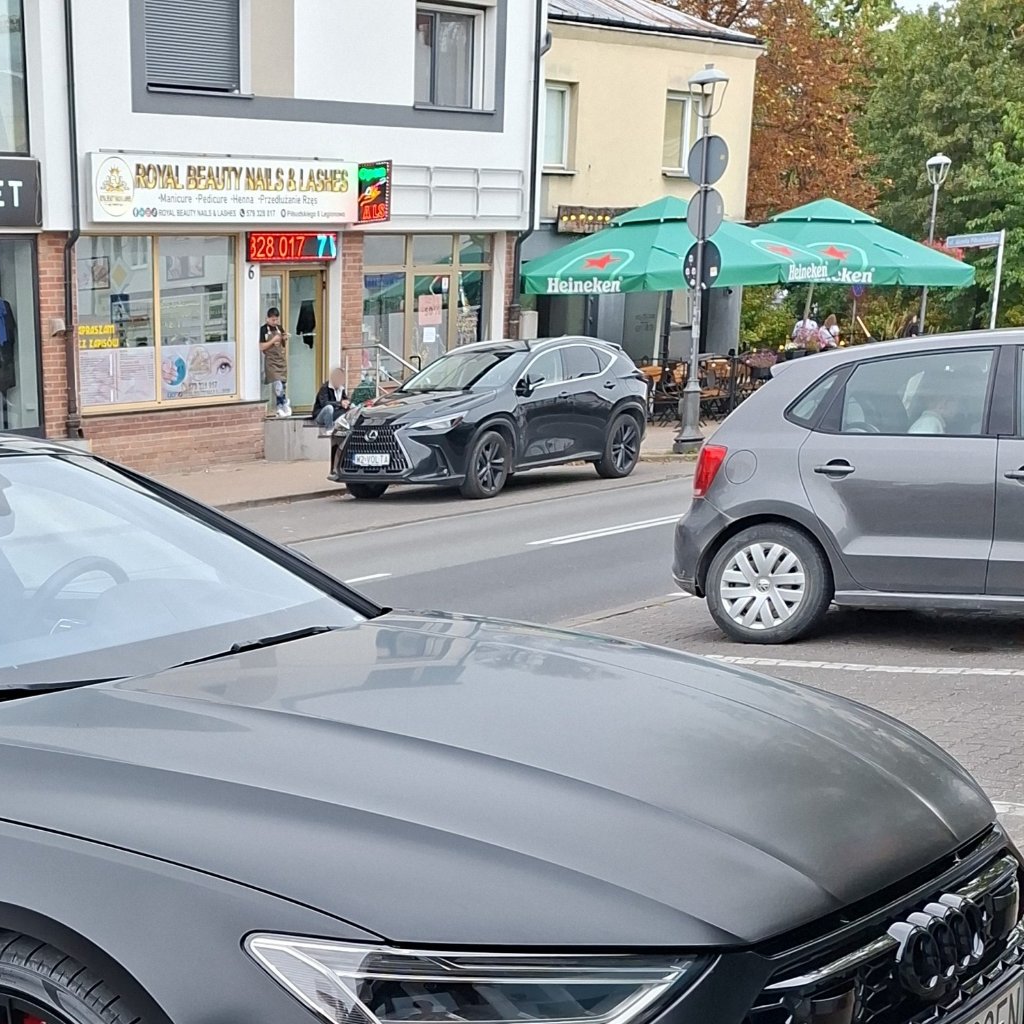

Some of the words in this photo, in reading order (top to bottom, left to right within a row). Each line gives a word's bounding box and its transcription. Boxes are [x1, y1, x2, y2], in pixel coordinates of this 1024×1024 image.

[134, 163, 184, 190] ROYAL
[185, 165, 243, 191] BEAUTY
[245, 167, 284, 192] NAILS
[287, 169, 297, 192] &
[298, 169, 349, 193] LASHES
[158, 209, 175, 217] ROYAL
[176, 209, 196, 217] BEAUTY
[197, 209, 212, 217] NAILS
[217, 209, 237, 217] LASHES
[279, 236, 305, 258] 017
[248, 265, 255, 279] 6
[788, 262, 829, 281] Heineken
[547, 277, 621, 293] Heineken
